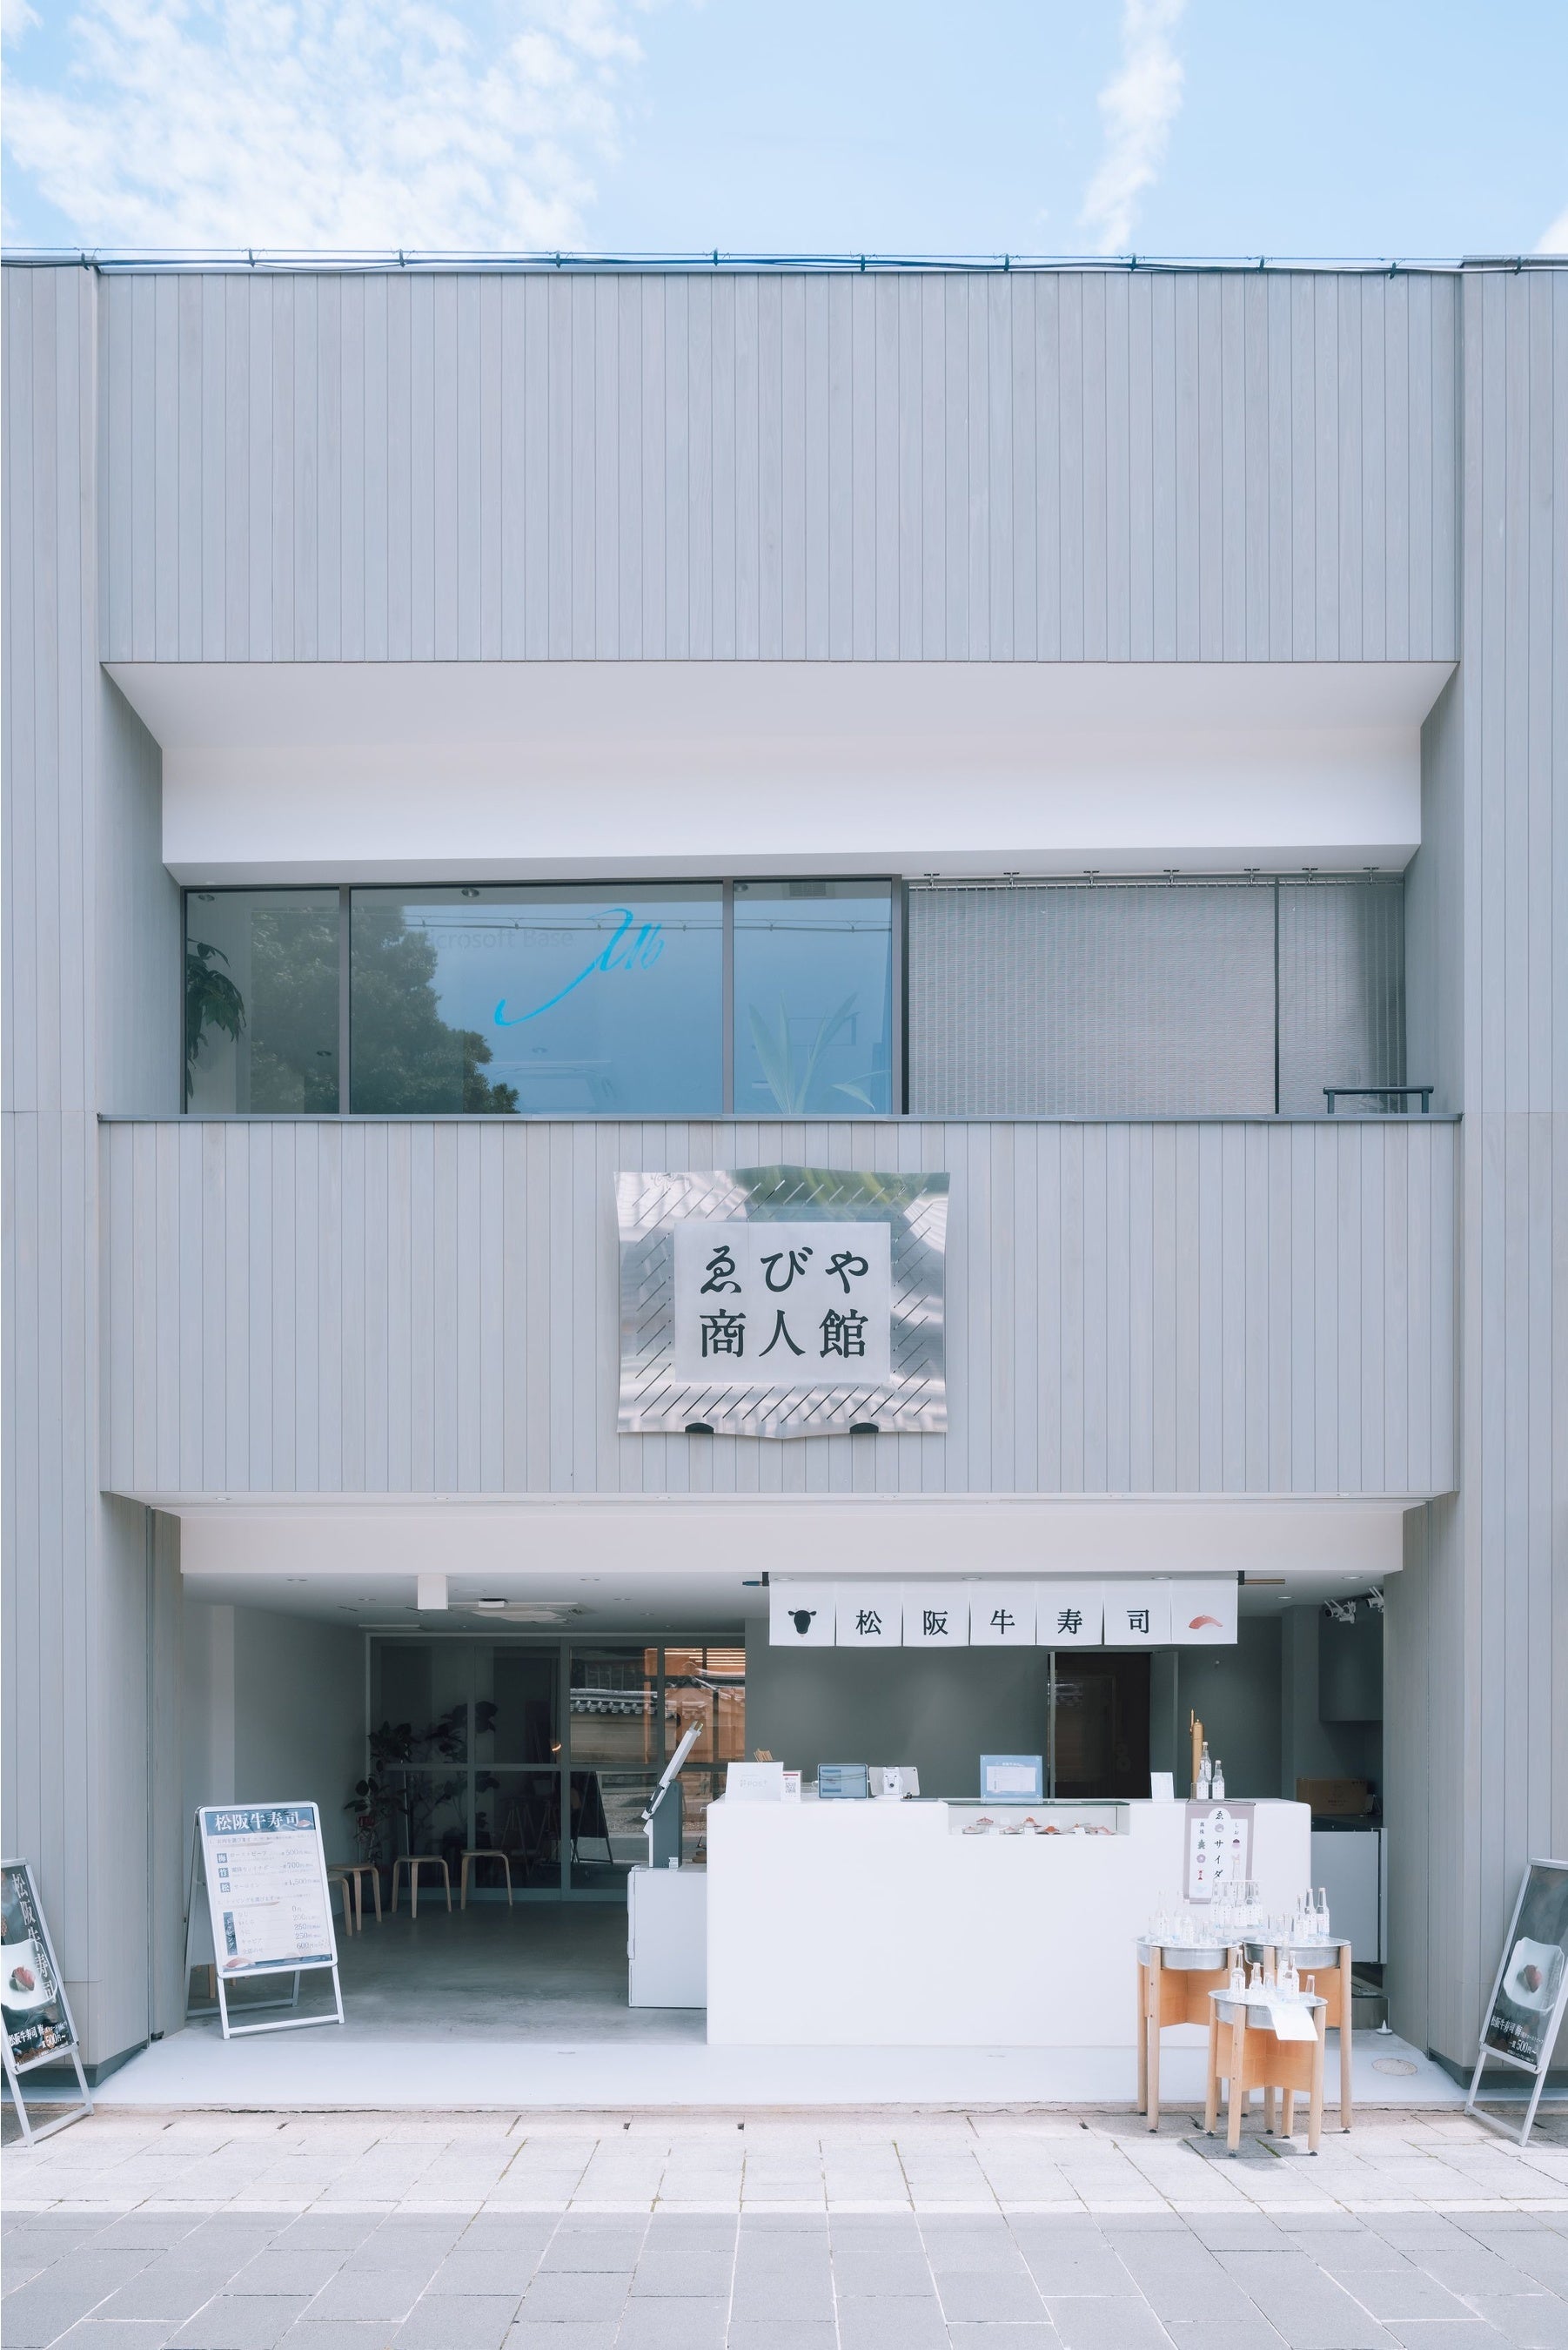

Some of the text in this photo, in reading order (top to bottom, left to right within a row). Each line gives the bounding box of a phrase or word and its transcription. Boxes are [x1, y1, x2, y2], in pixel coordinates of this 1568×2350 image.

[523, 930, 575, 949] Base
[700, 1246, 869, 1294] ゑびや
[700, 1308, 868, 1358] 商人館
[855, 1608, 1151, 1635] 松阪牛寿司
[214, 1810, 299, 1831] 松阪牛寿司
[11, 1873, 53, 2000] 松阪牛寿司
[8, 2026, 38, 2046] 松阪牛寿司
[1491, 2016, 1516, 2033] 松阪牛寿司
